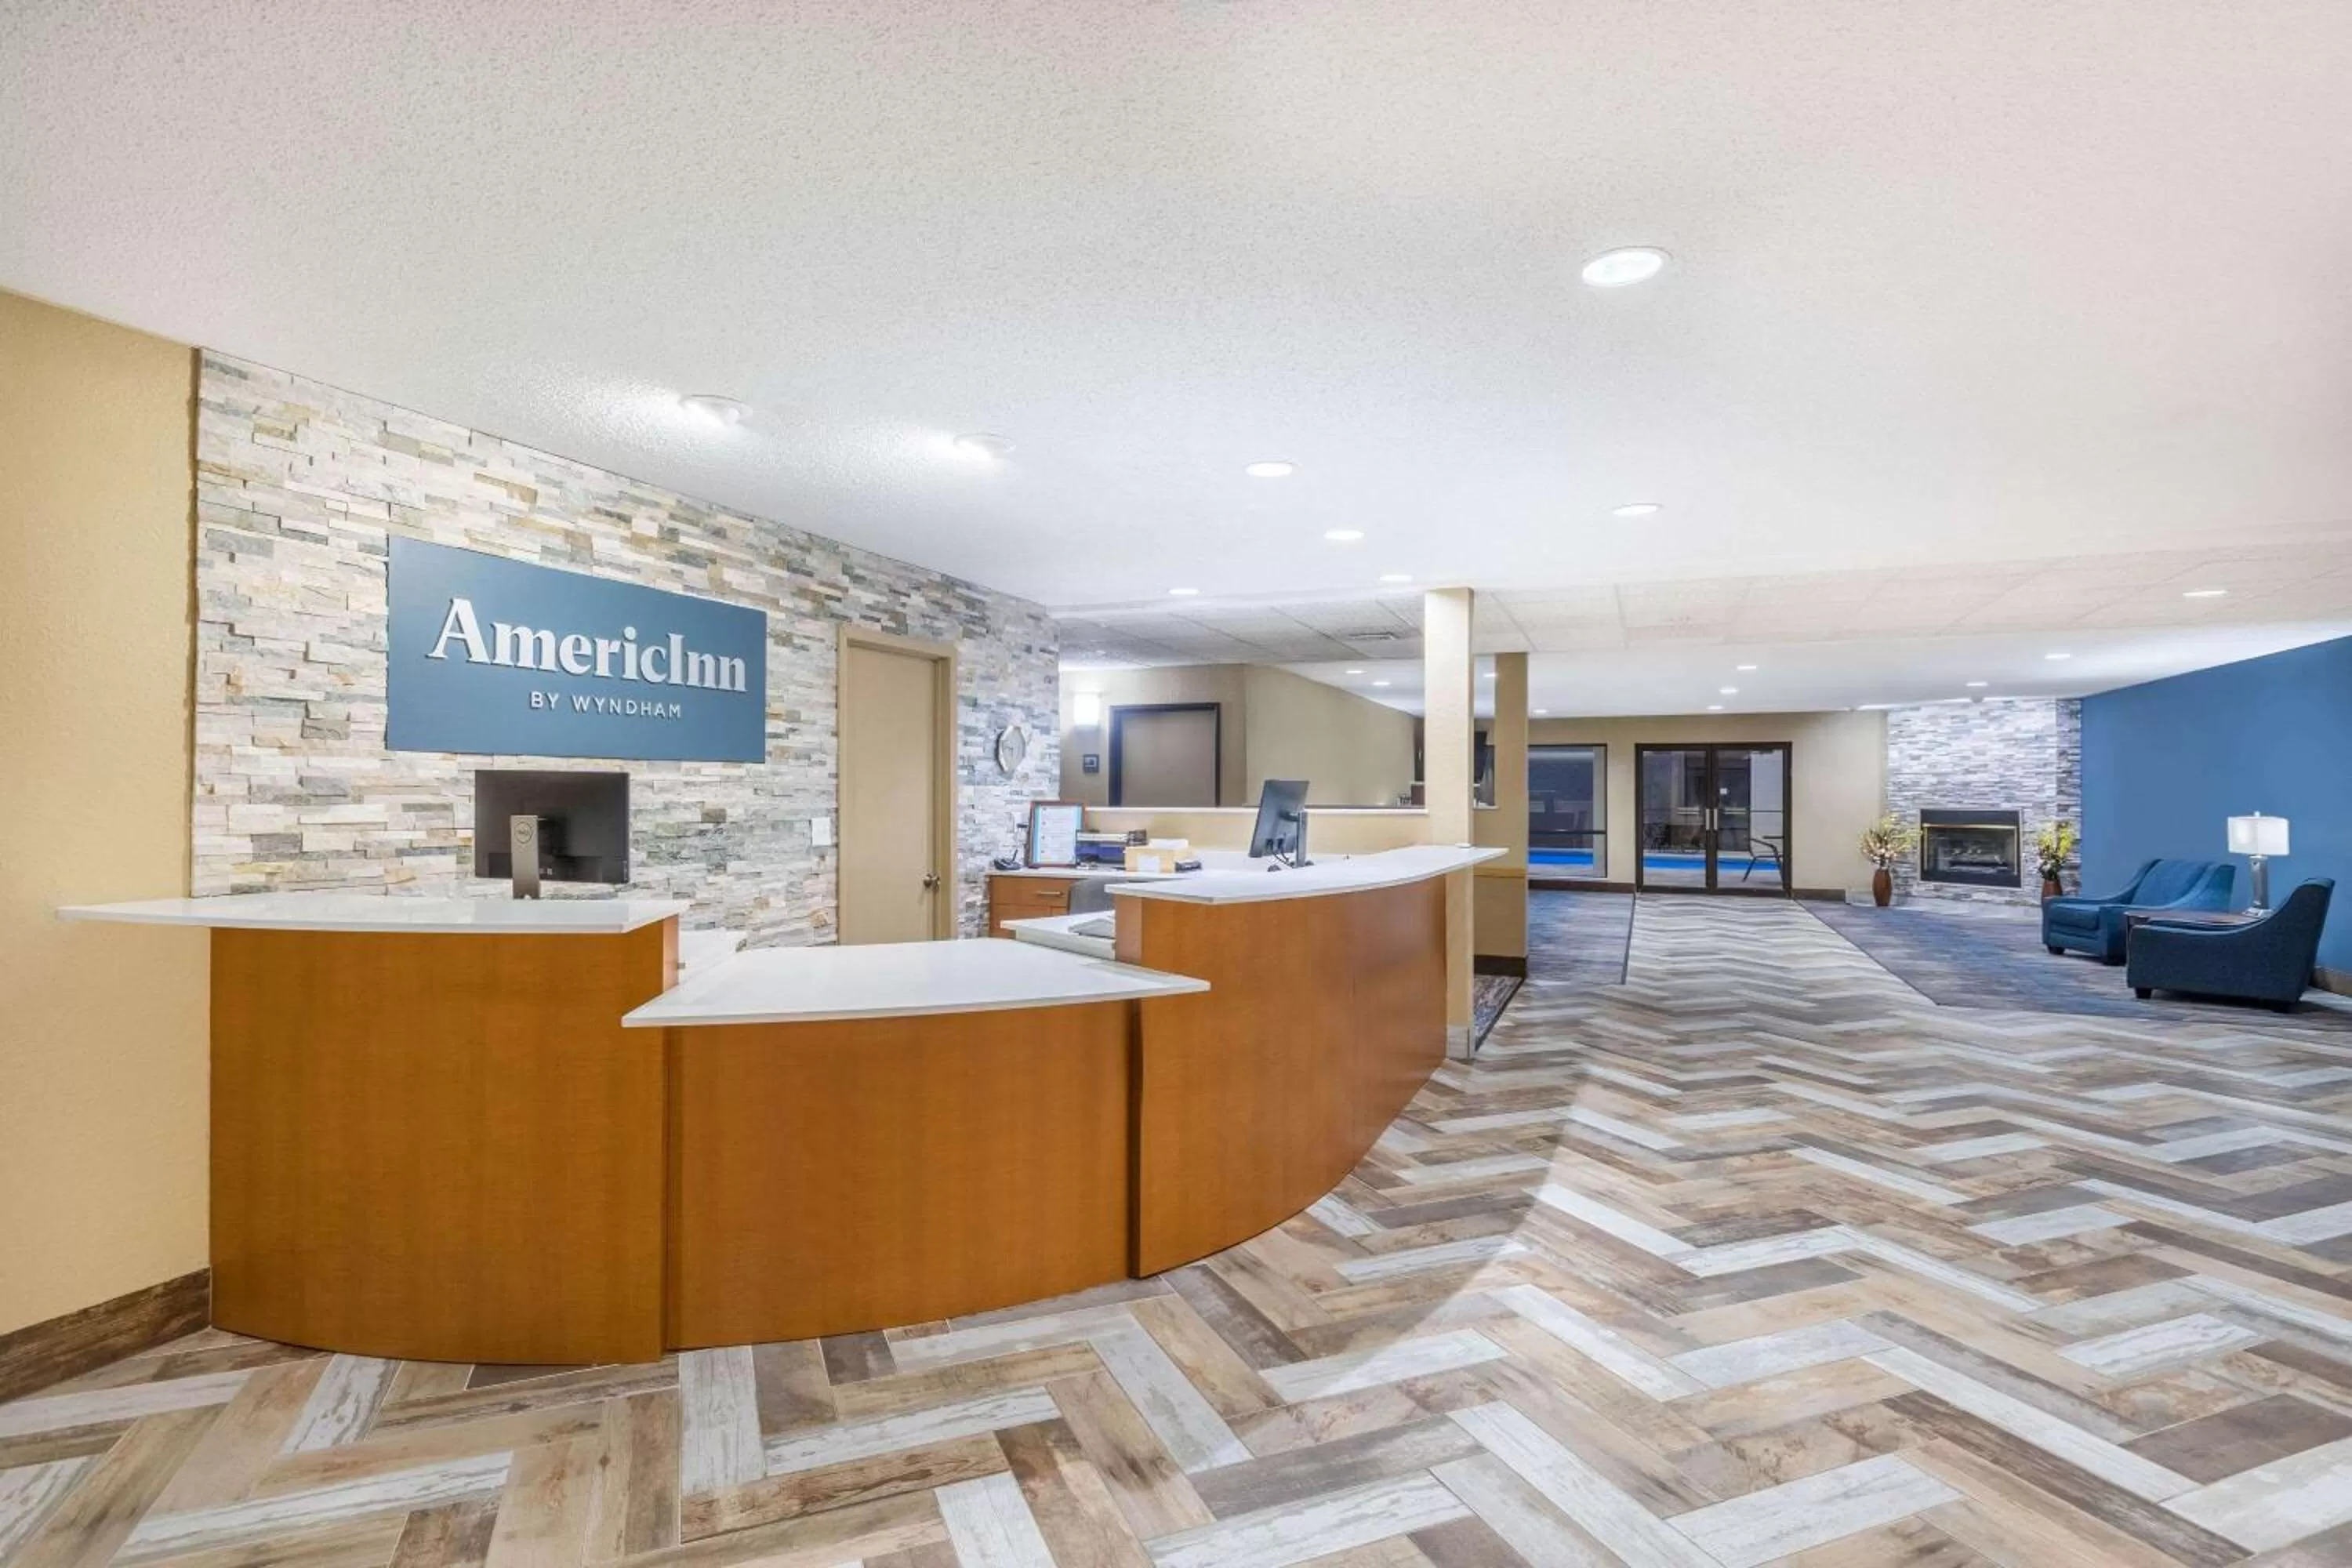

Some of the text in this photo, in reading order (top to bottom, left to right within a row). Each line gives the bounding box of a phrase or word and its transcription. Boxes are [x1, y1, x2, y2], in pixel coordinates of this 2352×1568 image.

[426, 597, 747, 692] AmericInn
[530, 691, 682, 719] BY WYNDHAM
